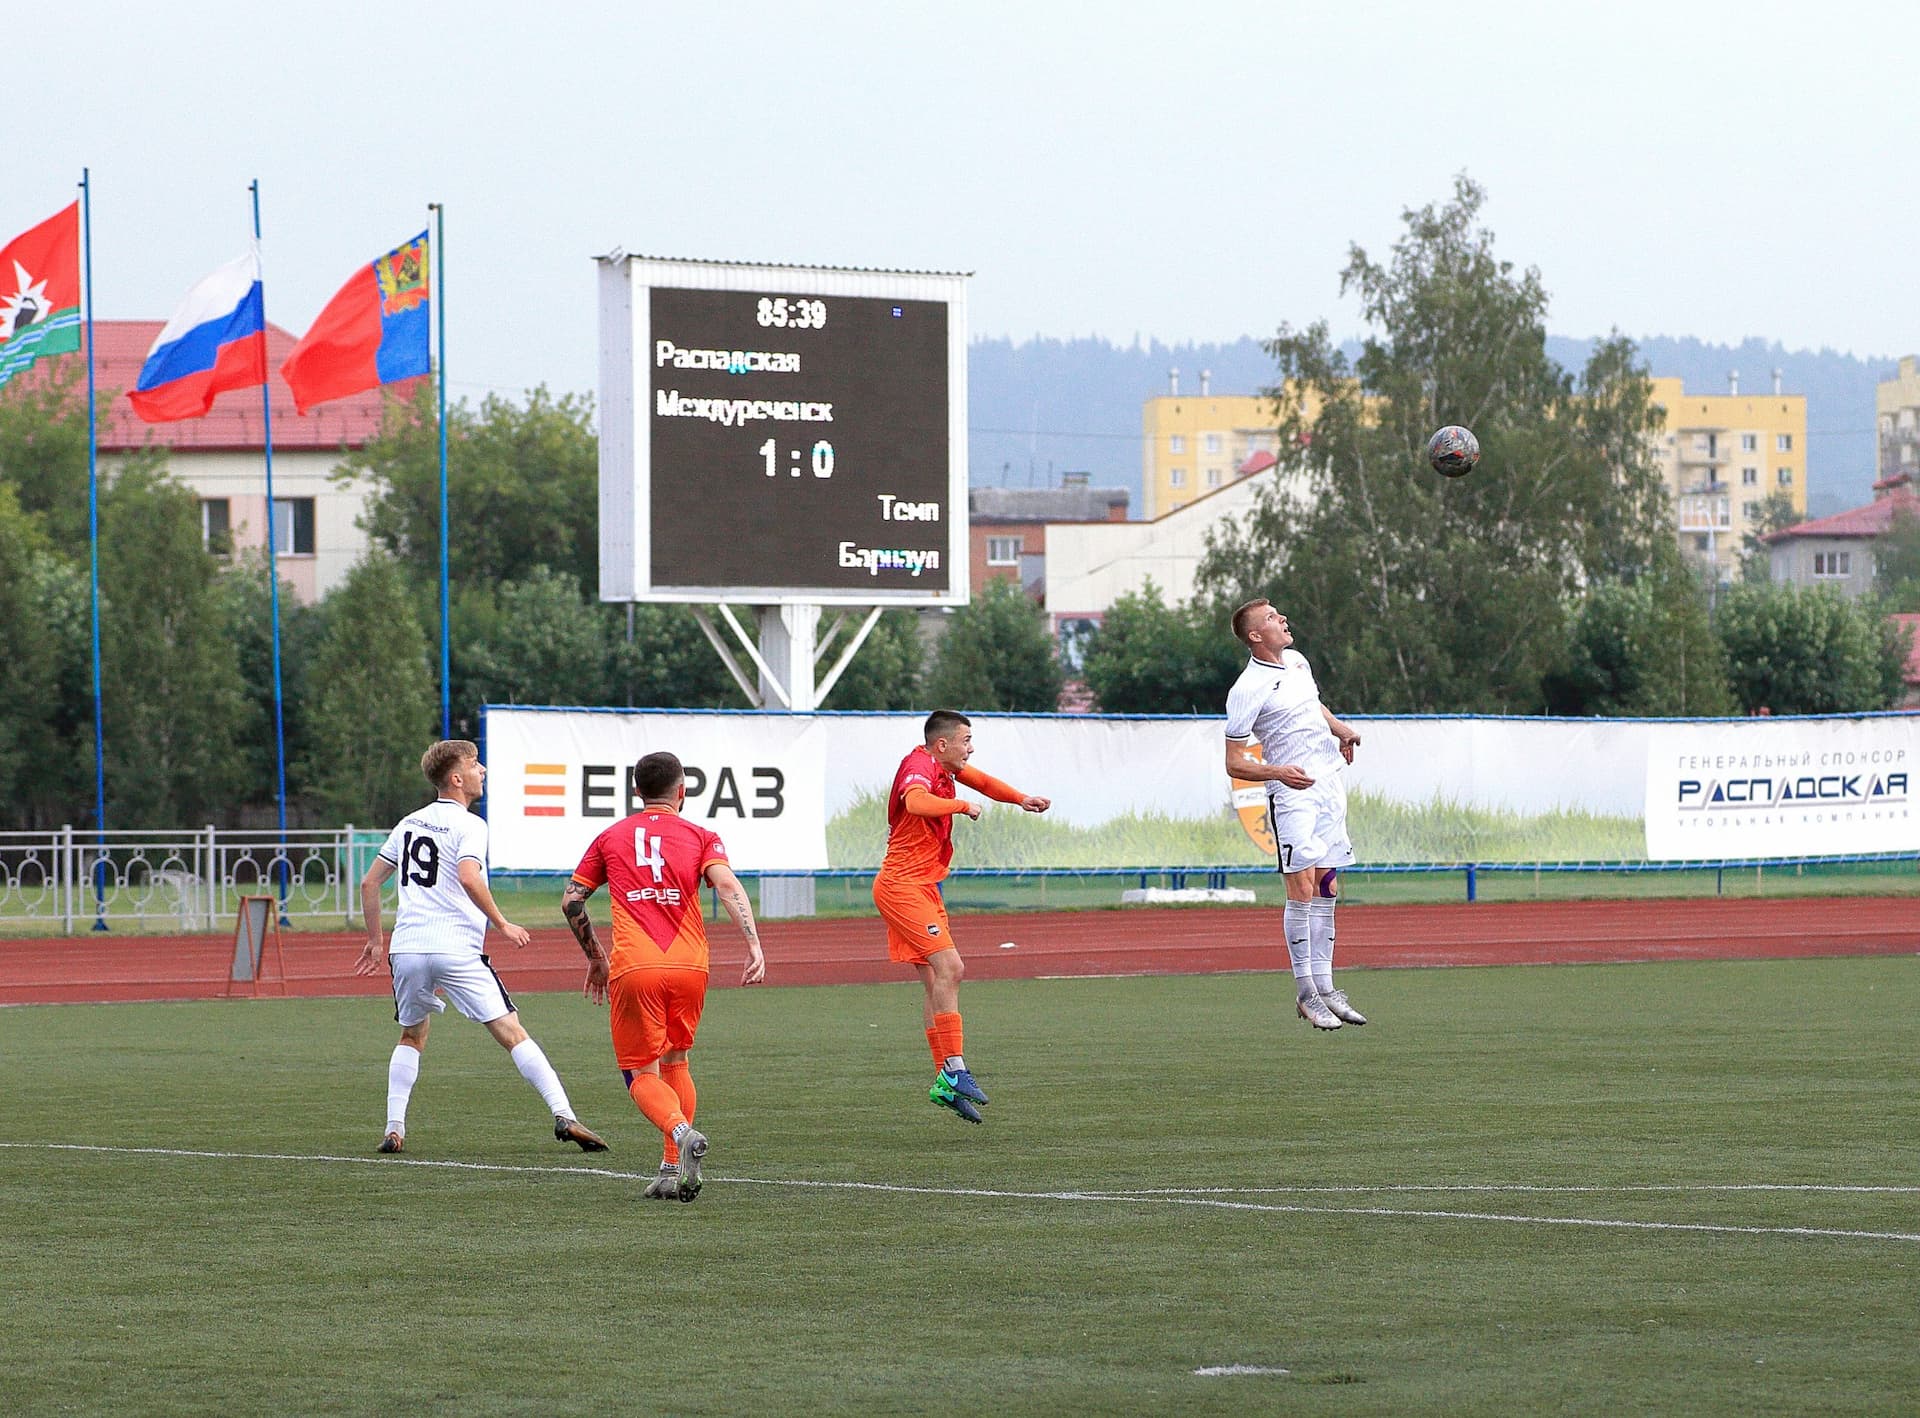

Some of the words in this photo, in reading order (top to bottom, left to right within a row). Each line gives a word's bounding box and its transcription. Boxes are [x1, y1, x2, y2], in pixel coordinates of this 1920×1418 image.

[757, 298, 827, 329] 85:39
[656, 340, 800, 374] Распадская
[1678, 751, 1811, 769] ГЕНЕРАЛЬНЫЙ
[1820, 749, 1906, 766] СПОНСОР
[1678, 773, 1908, 803] РАСПАДСКАЯ
[401, 831, 439, 888] 19
[634, 826, 666, 883] 4
[1282, 843, 1293, 867] 7
